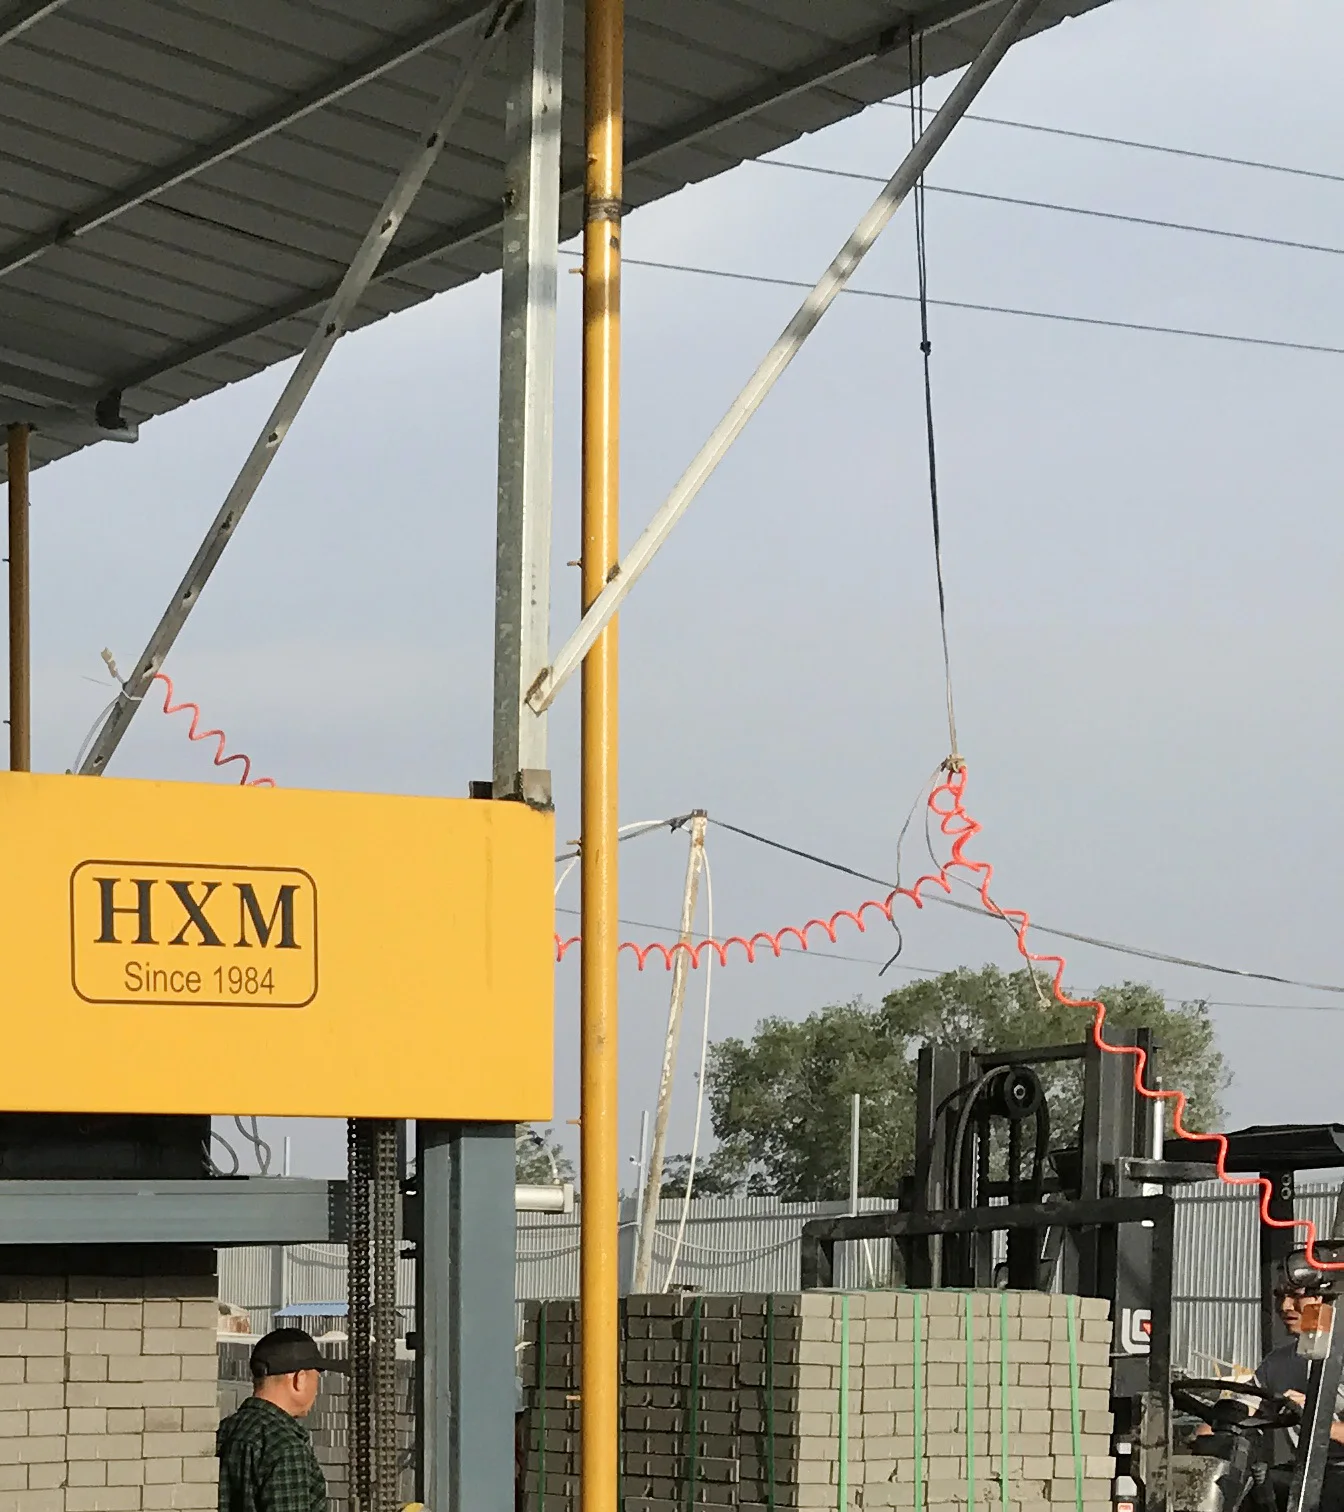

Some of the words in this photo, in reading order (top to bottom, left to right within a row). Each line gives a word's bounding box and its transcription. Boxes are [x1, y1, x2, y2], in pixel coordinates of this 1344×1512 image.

[92, 877, 302, 950] HXM
[124, 961, 202, 993] Since
[213, 965, 275, 996] 1984
